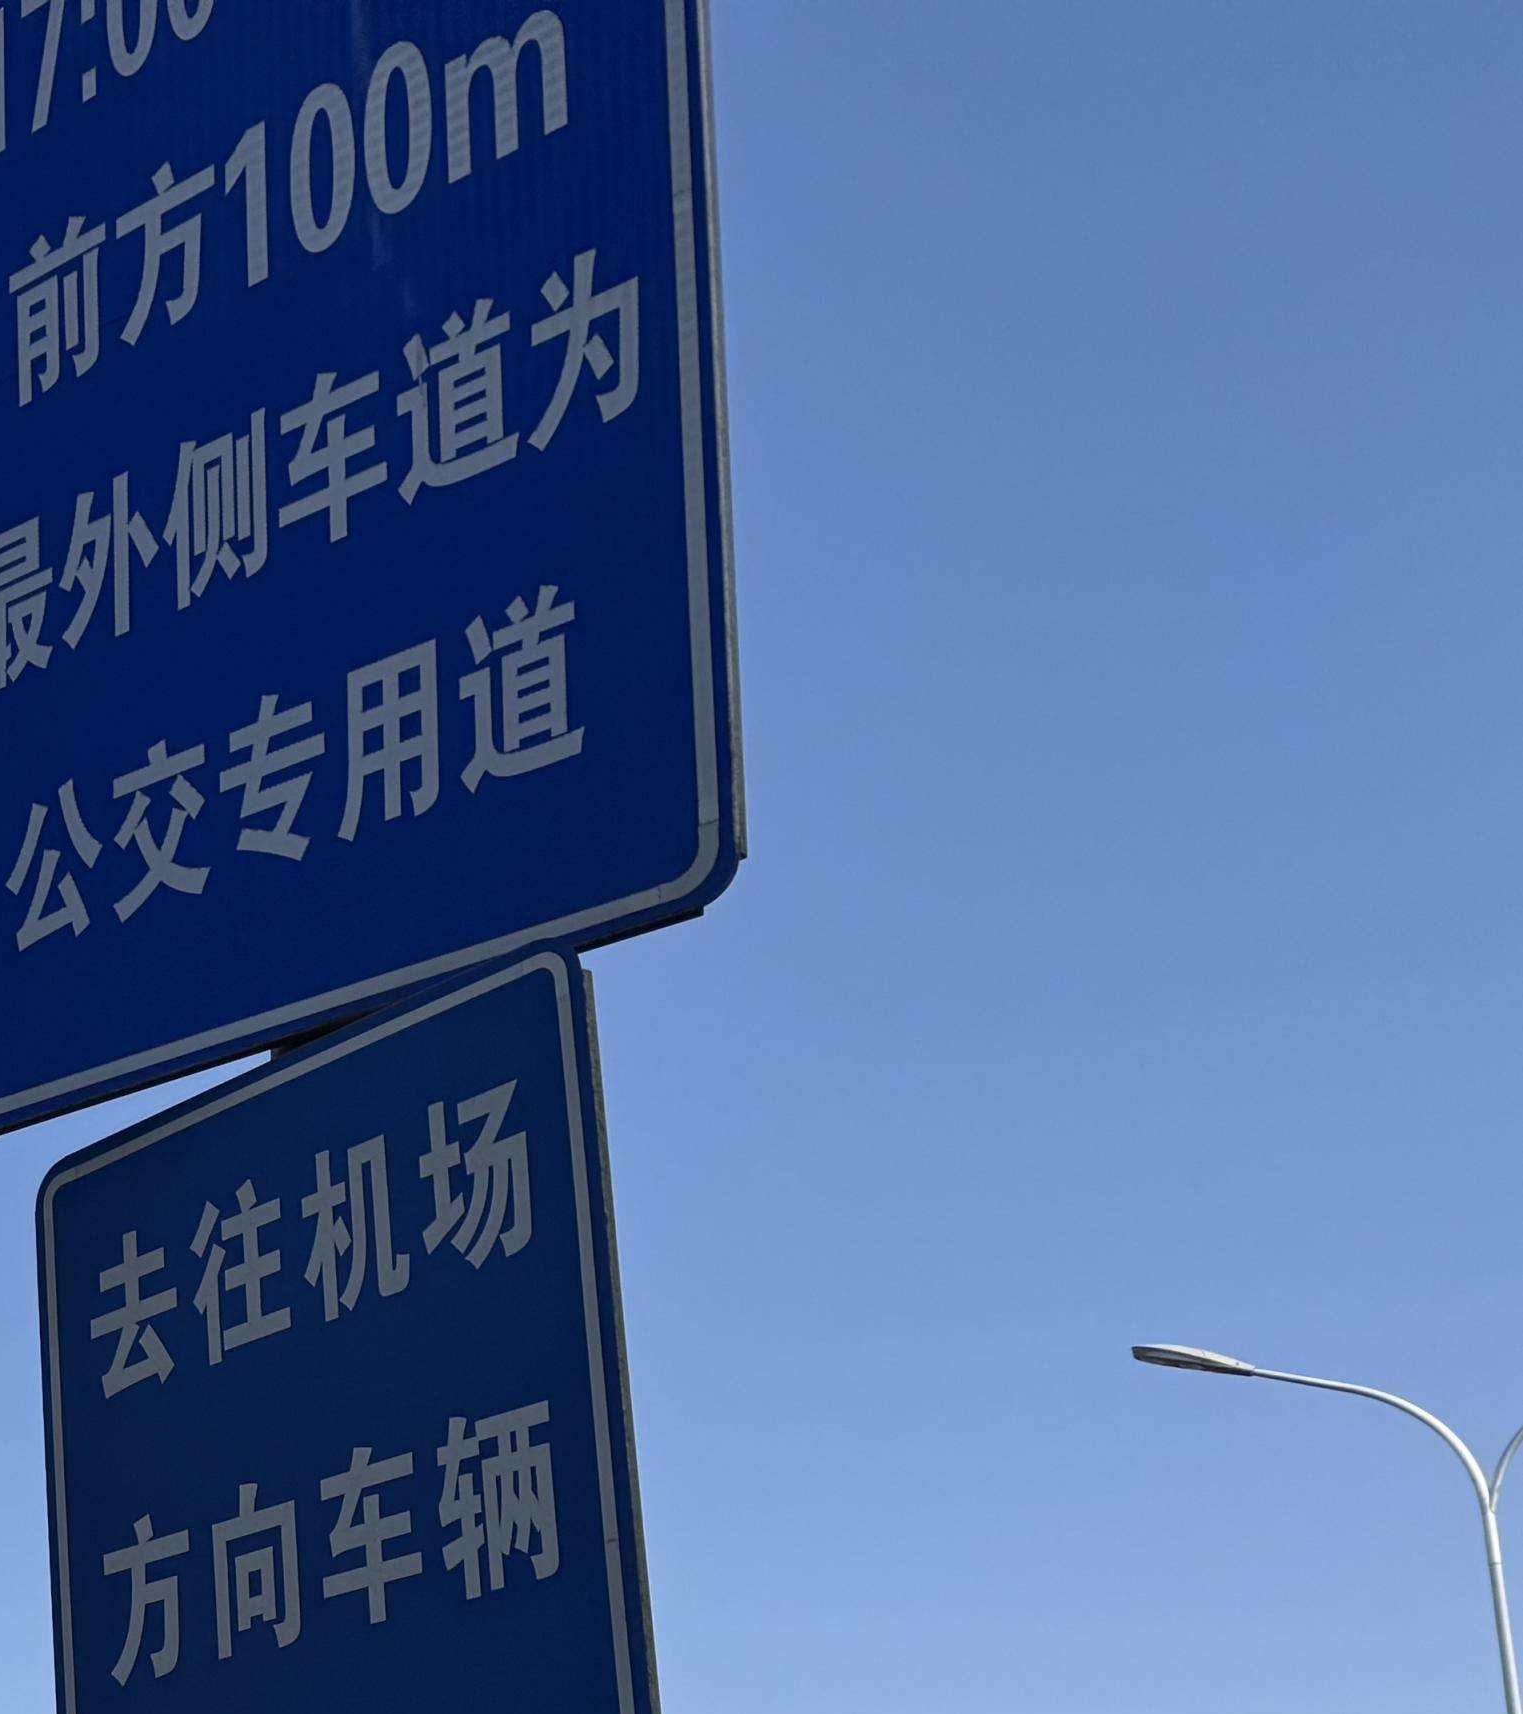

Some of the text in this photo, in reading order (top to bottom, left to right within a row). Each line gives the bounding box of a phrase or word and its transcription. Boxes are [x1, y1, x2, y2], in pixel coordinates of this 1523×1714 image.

[8, 9, 568, 407] 前方100m
[5, 584, 585, 952] 公交专用道
[90, 1079, 532, 1399] 去往机场
[103, 1399, 560, 1687] 方向车辆
